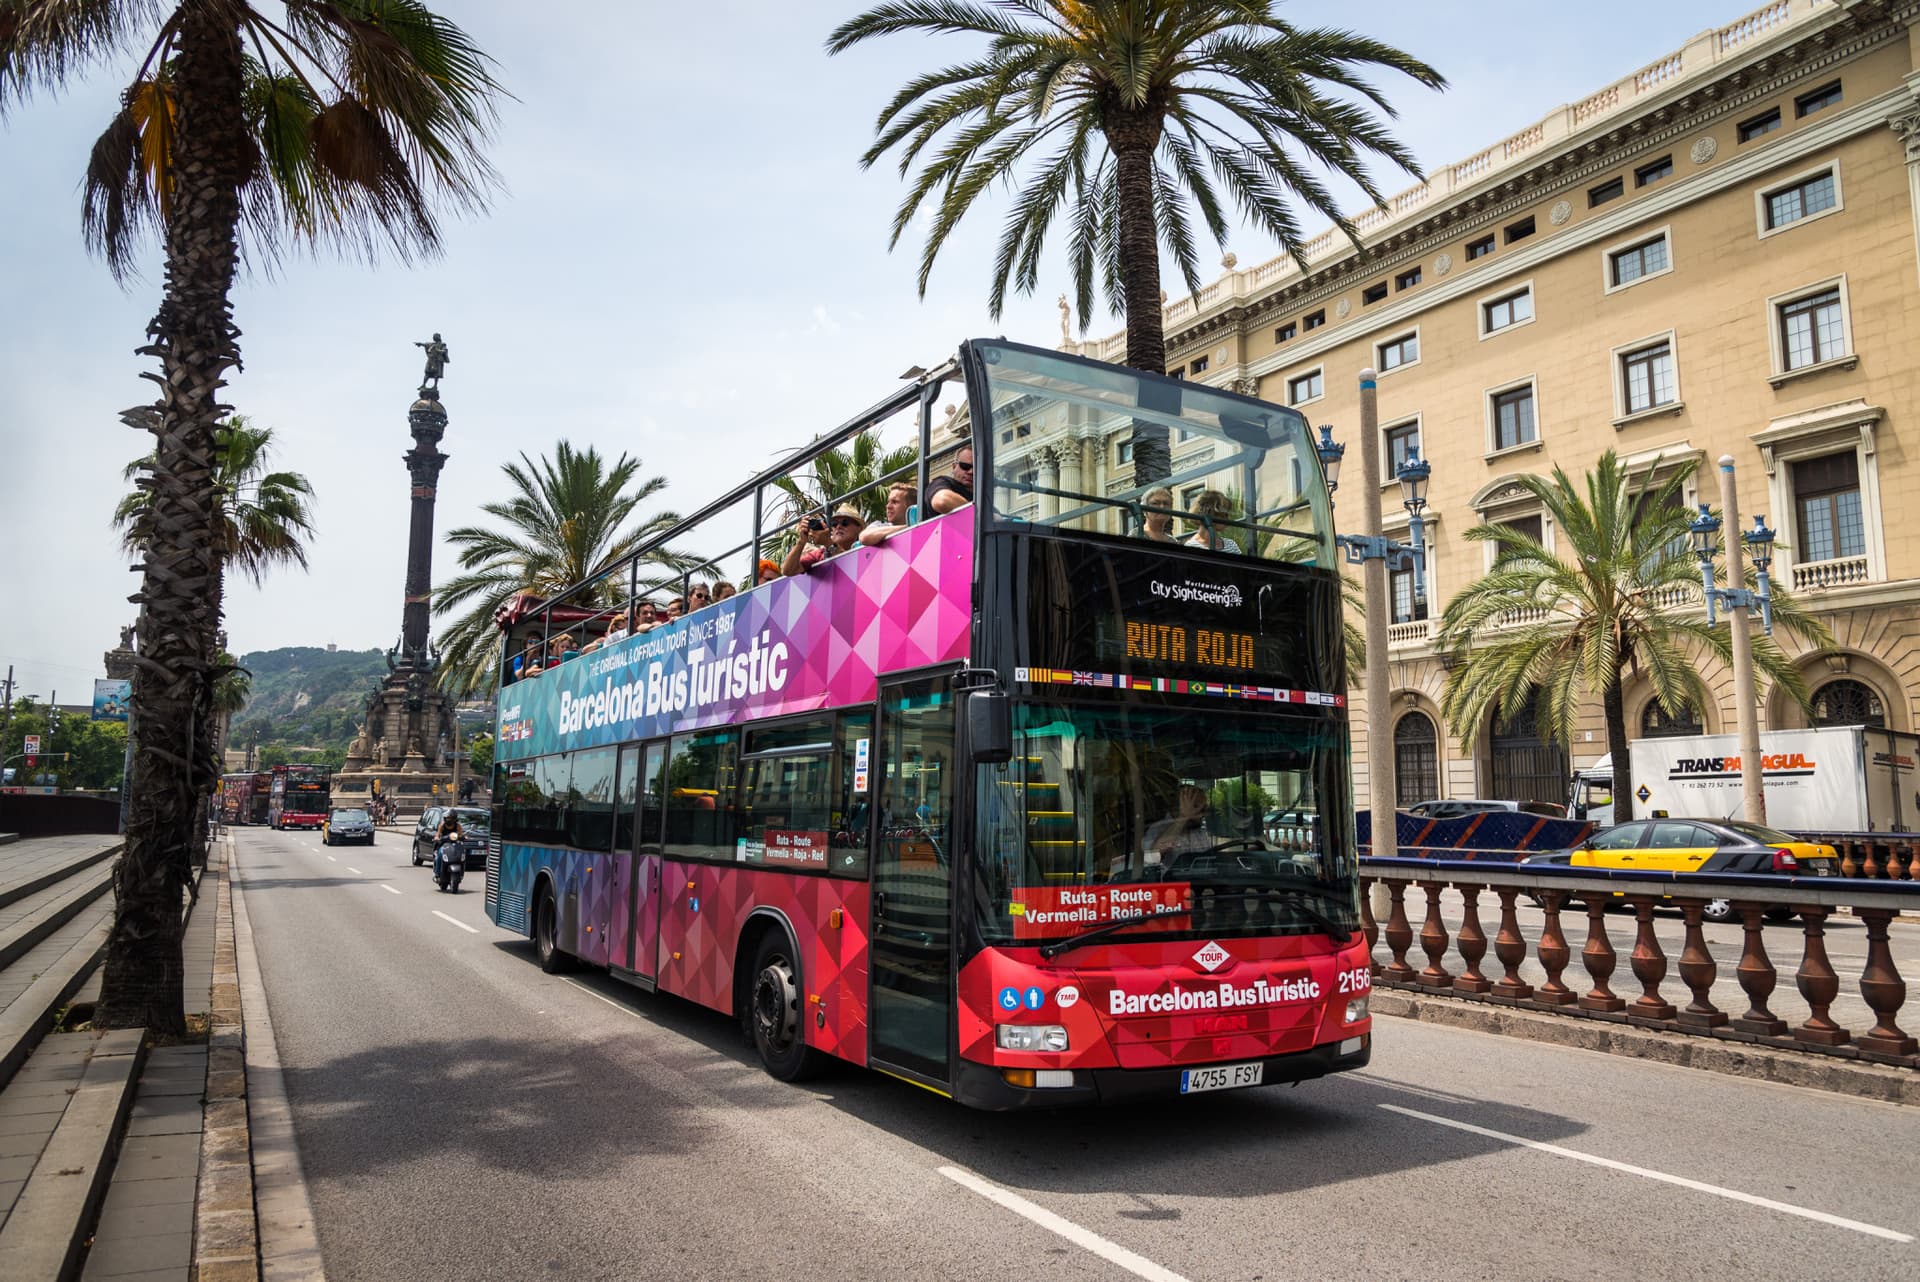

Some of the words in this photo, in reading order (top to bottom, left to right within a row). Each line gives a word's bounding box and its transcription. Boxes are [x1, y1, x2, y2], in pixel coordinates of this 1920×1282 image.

[1150, 580, 1171, 598] City
[1172, 584, 1231, 607] Sightseeing
[1185, 580, 1221, 591] Worldwide
[589, 663, 600, 677] THE
[600, 650, 628, 673] ORIGINAL
[628, 651, 634, 665] &
[633, 637, 664, 662] OFFICIAL
[666, 630, 688, 651] TOUR
[688, 619, 714, 643] SINCE
[714, 612, 736, 635] 1987
[1127, 622, 1186, 662] RUTA
[1197, 629, 1254, 669] ROJA
[558, 675, 644, 735] Barcelona
[777, 834, 789, 845] Ruta
[793, 835, 812, 846] Route
[793, 848, 807, 862] Roja
[812, 849, 824, 861] Red
[1060, 891, 1097, 905] Ruta
[1110, 888, 1152, 902] Route
[1025, 908, 1097, 924] Vermella
[1200, 952, 1223, 962] TOUR
[1338, 967, 1370, 993] 2156
[1109, 986, 1218, 1014] Barcelona
[1192, 1068, 1227, 1089] 4755
[1234, 1064, 1260, 1085] FSY
